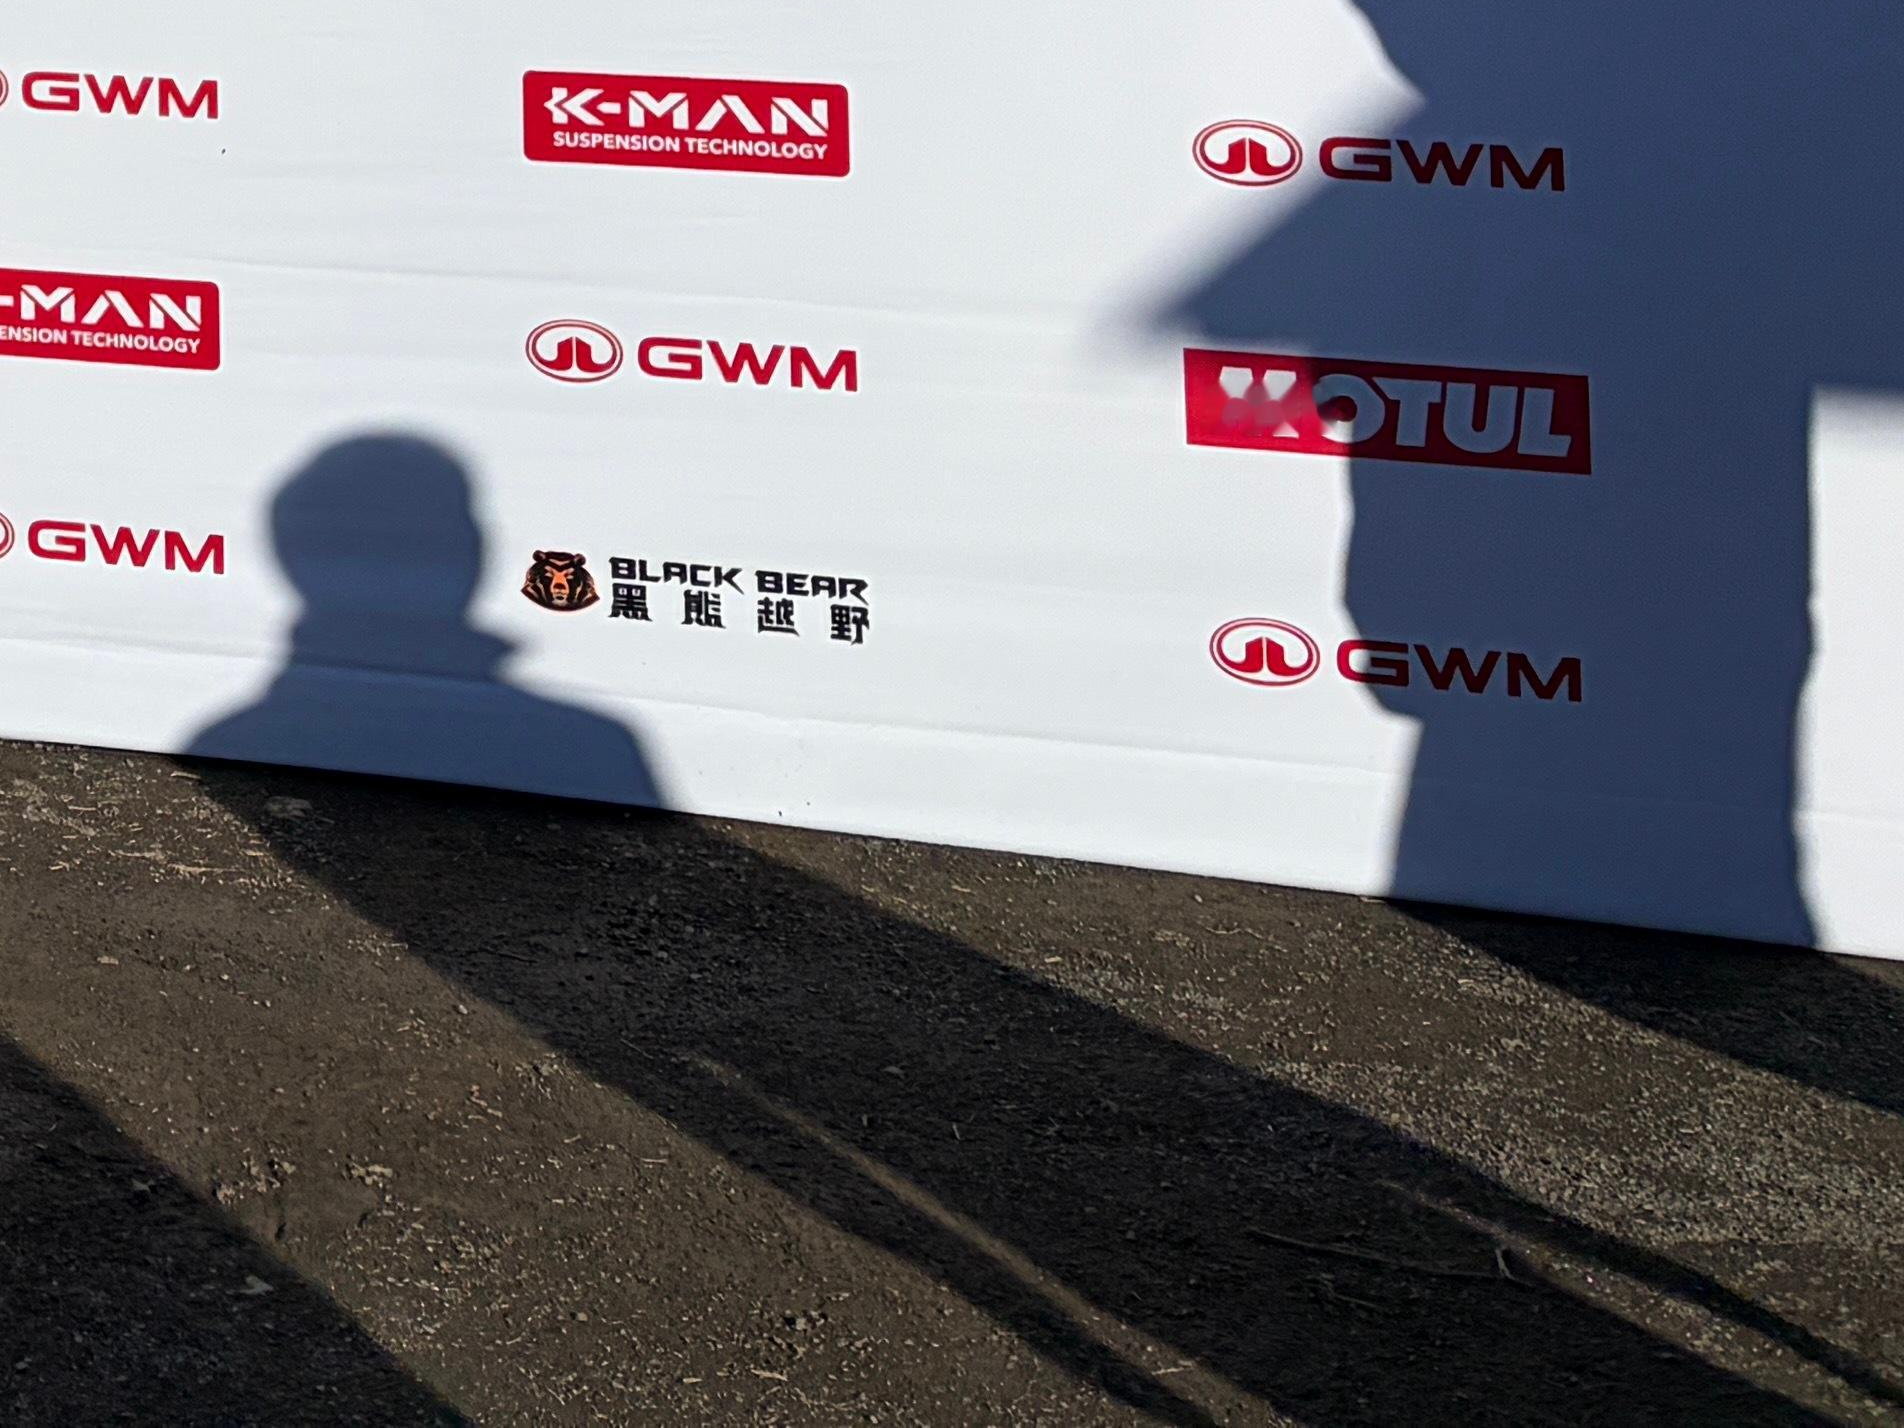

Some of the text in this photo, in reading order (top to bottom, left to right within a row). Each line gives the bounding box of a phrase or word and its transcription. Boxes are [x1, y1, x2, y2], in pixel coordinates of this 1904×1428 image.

[21, 71, 219, 119] GWM
[543, 86, 830, 137] K-MAN
[553, 130, 829, 160] SUSPENSION TECHNOLOGY
[1318, 136, 1565, 191] GWM
[71, 330, 202, 354] TECHNOLOGY
[637, 336, 858, 392] GWM
[27, 519, 225, 575] GWM
[608, 556, 869, 606] BLACK BEAR
[1336, 639, 1582, 703] GWM
